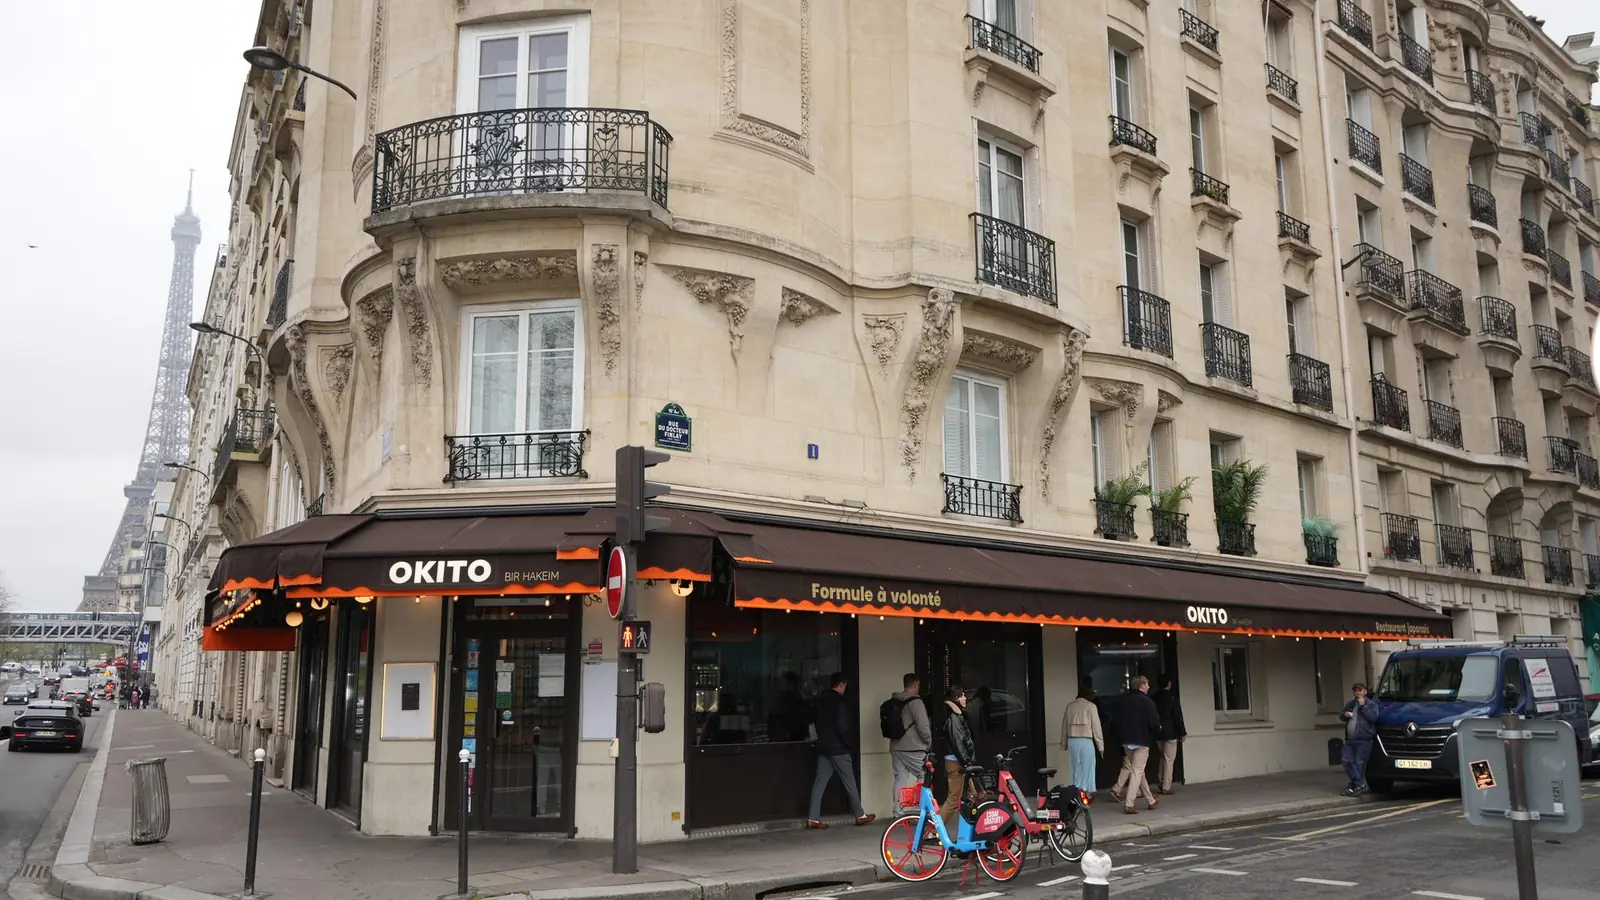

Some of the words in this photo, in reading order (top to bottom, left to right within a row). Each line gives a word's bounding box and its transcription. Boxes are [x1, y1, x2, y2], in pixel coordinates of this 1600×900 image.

[666, 426, 688, 434] DOCTEUR
[388, 559, 492, 584] OKITO
[504, 572, 520, 582] BIR
[522, 571, 560, 581] HAKEIM
[811, 583, 873, 602] Formule
[877, 586, 887, 603] à
[891, 589, 942, 607] volonté
[1186, 605, 1228, 625] OKITO
[1375, 621, 1407, 633] Restaurant
[1406, 622, 1430, 636] japonais
